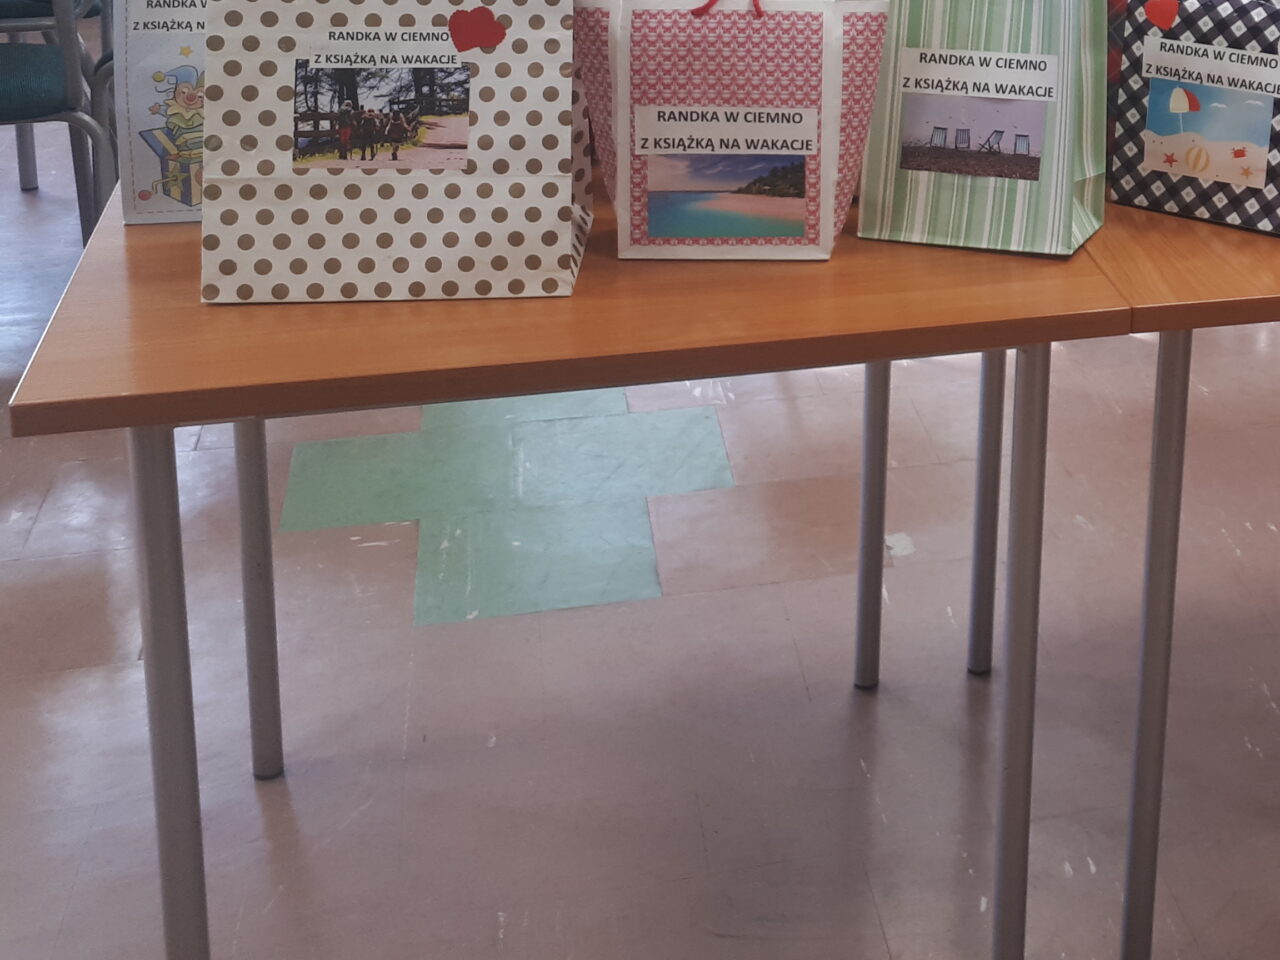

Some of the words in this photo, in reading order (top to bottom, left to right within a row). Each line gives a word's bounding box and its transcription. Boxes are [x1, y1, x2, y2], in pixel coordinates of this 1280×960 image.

[146, 0, 197, 9] RANDKA
[133, 21, 140, 30] Z
[143, 19, 193, 32] KSIĄŻKĄ
[328, 31, 382, 41] RANDKA
[384, 31, 398, 41] W
[400, 31, 450, 42] CIEMNO
[314, 54, 322, 64] Z
[325, 52, 377, 67] KSIĄŻKĄ
[380, 54, 398, 65] NA
[401, 54, 458, 65] WAKACJE
[919, 52, 975, 67] RANDKA
[979, 56, 992, 68] W
[995, 57, 1047, 72] CIEMNO
[1159, 41, 1209, 59] RANDKA
[1213, 50, 1226, 61] W
[1228, 52, 1279, 69] CIEMNO
[1145, 64, 1153, 74] Z
[1155, 65, 1203, 84] KSIĄŻKĄ
[1207, 73, 1224, 85] NA
[902, 77, 911, 88] Z
[914, 77, 969, 95] KSIĄŻKĄ
[972, 82, 991, 93] NA
[995, 83, 1054, 98] WAKACJE
[657, 110, 720, 123] RANDKA
[724, 111, 739, 123] W
[744, 112, 803, 124] CIEMNO
[640, 138, 649, 149] Z
[653, 135, 715, 152] KSIĄŻKĄ
[719, 138, 741, 150] NA
[745, 138, 813, 151] WAKACJE
